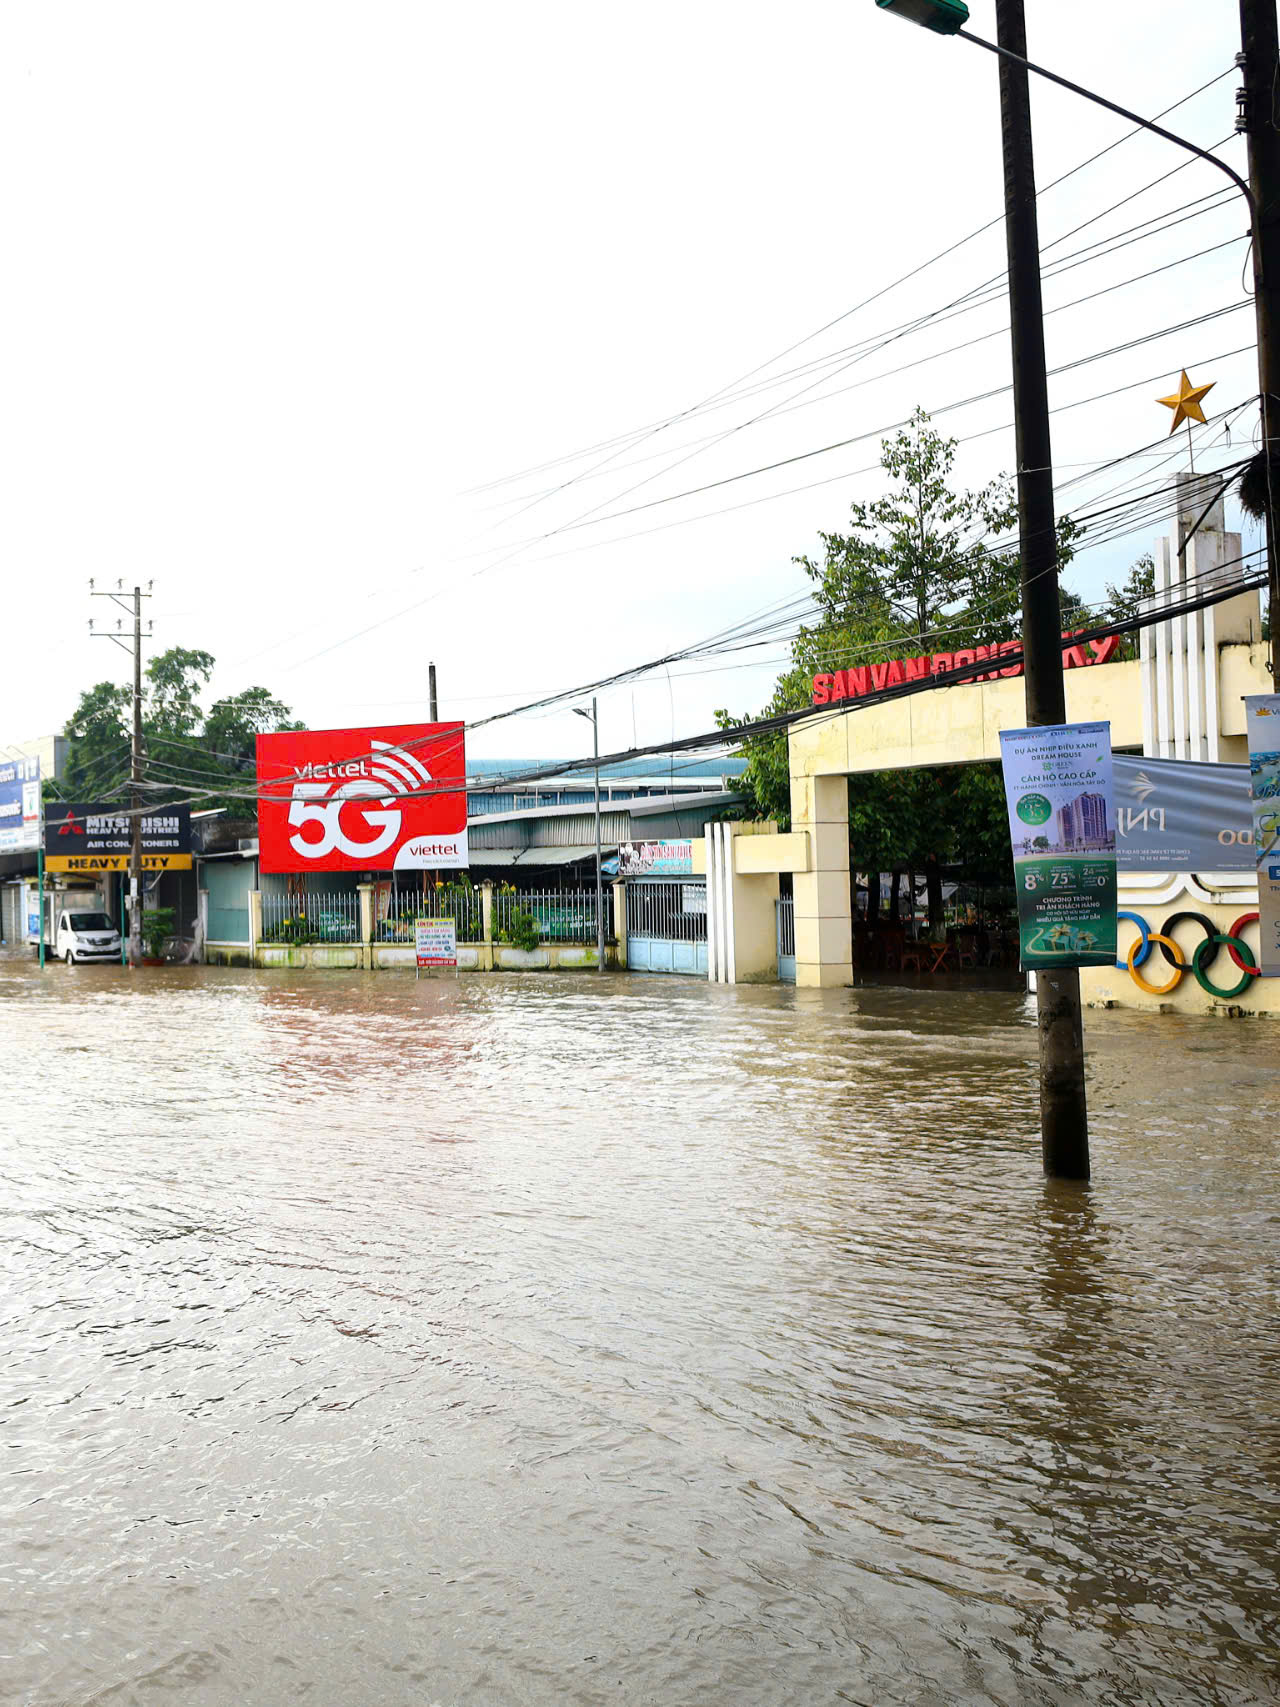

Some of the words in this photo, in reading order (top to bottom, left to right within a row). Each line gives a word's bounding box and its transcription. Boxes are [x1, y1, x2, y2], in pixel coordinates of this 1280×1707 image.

[1040, 745, 1057, 754] NHỊP
[1059, 743, 1075, 751] ĐIỆU
[1076, 742, 1098, 750] XANH
[294, 761, 369, 779] viettel
[1058, 772, 1077, 780] CAO
[1079, 769, 1097, 779] CẤP
[287, 779, 402, 858] 5G
[87, 840, 105, 848] AIR
[409, 844, 459, 856] viettel
[68, 858, 120, 869] HEAVY
[1058, 901, 1080, 909] KHÁCH
